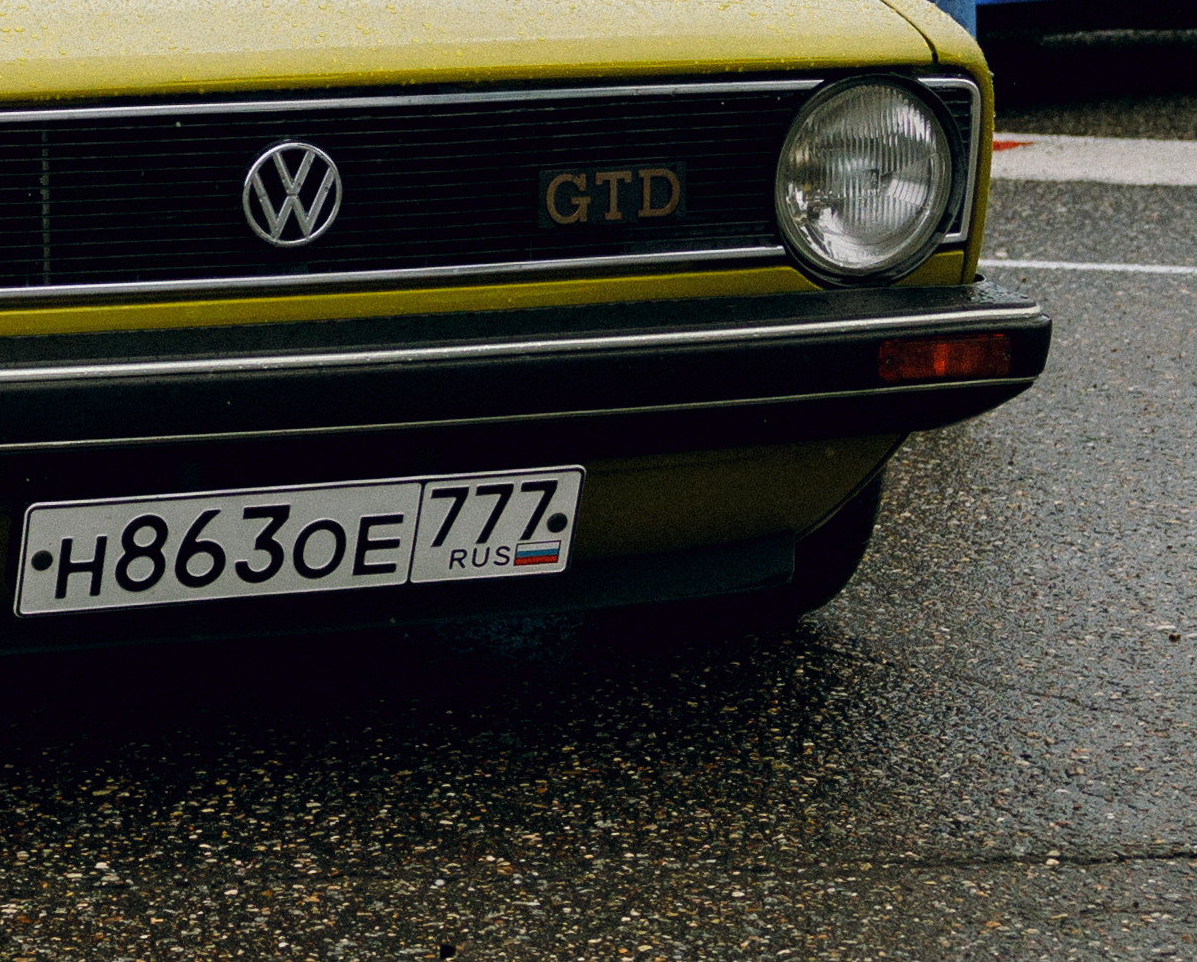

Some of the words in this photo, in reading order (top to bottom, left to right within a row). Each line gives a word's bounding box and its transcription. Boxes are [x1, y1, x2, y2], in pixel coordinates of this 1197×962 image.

[243, 141, 343, 248] VW
[546, 169, 680, 225] GTD
[430, 480, 559, 547] 777
[448, 545, 511, 570] RUS
